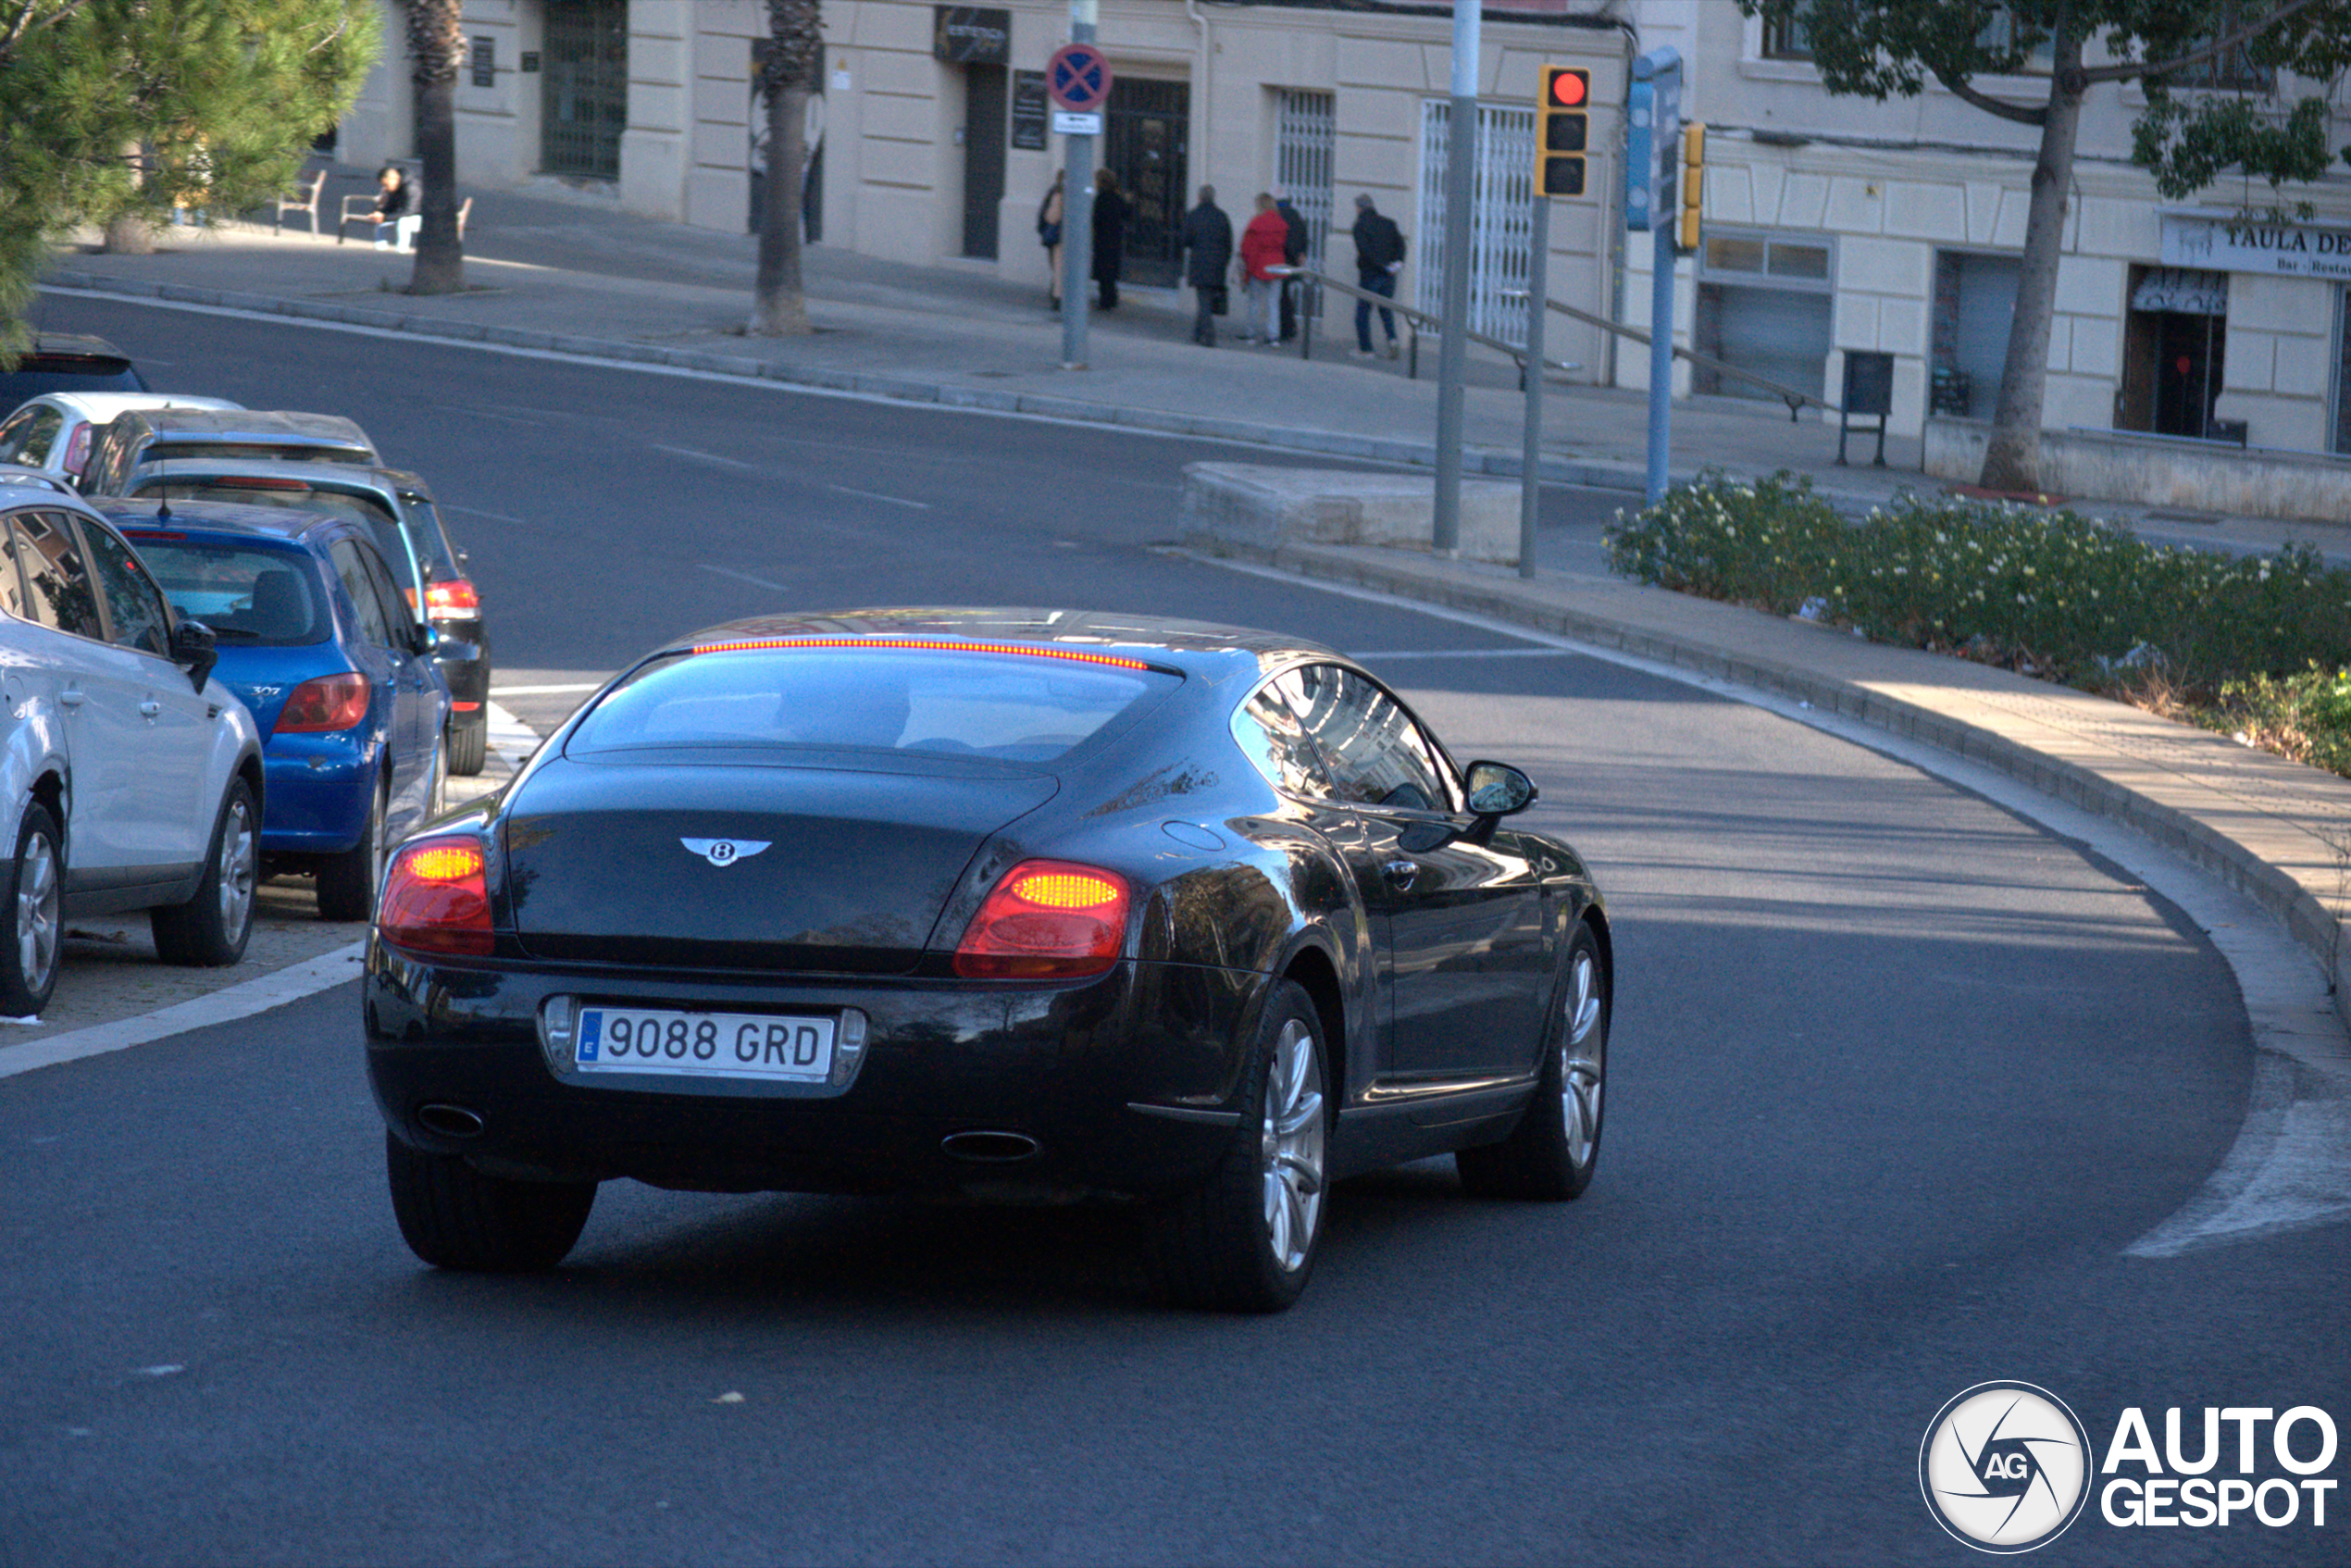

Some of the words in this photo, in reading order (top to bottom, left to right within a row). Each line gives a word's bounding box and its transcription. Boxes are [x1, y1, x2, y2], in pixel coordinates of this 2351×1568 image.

[2227, 225, 2307, 252] TAULA
[2277, 259, 2297, 270] Bar
[251, 686, 281, 697] 307
[714, 842, 732, 859] B
[584, 1041, 594, 1053] E
[608, 1017, 717, 1060] 9088
[735, 1022, 819, 1066] GRD
